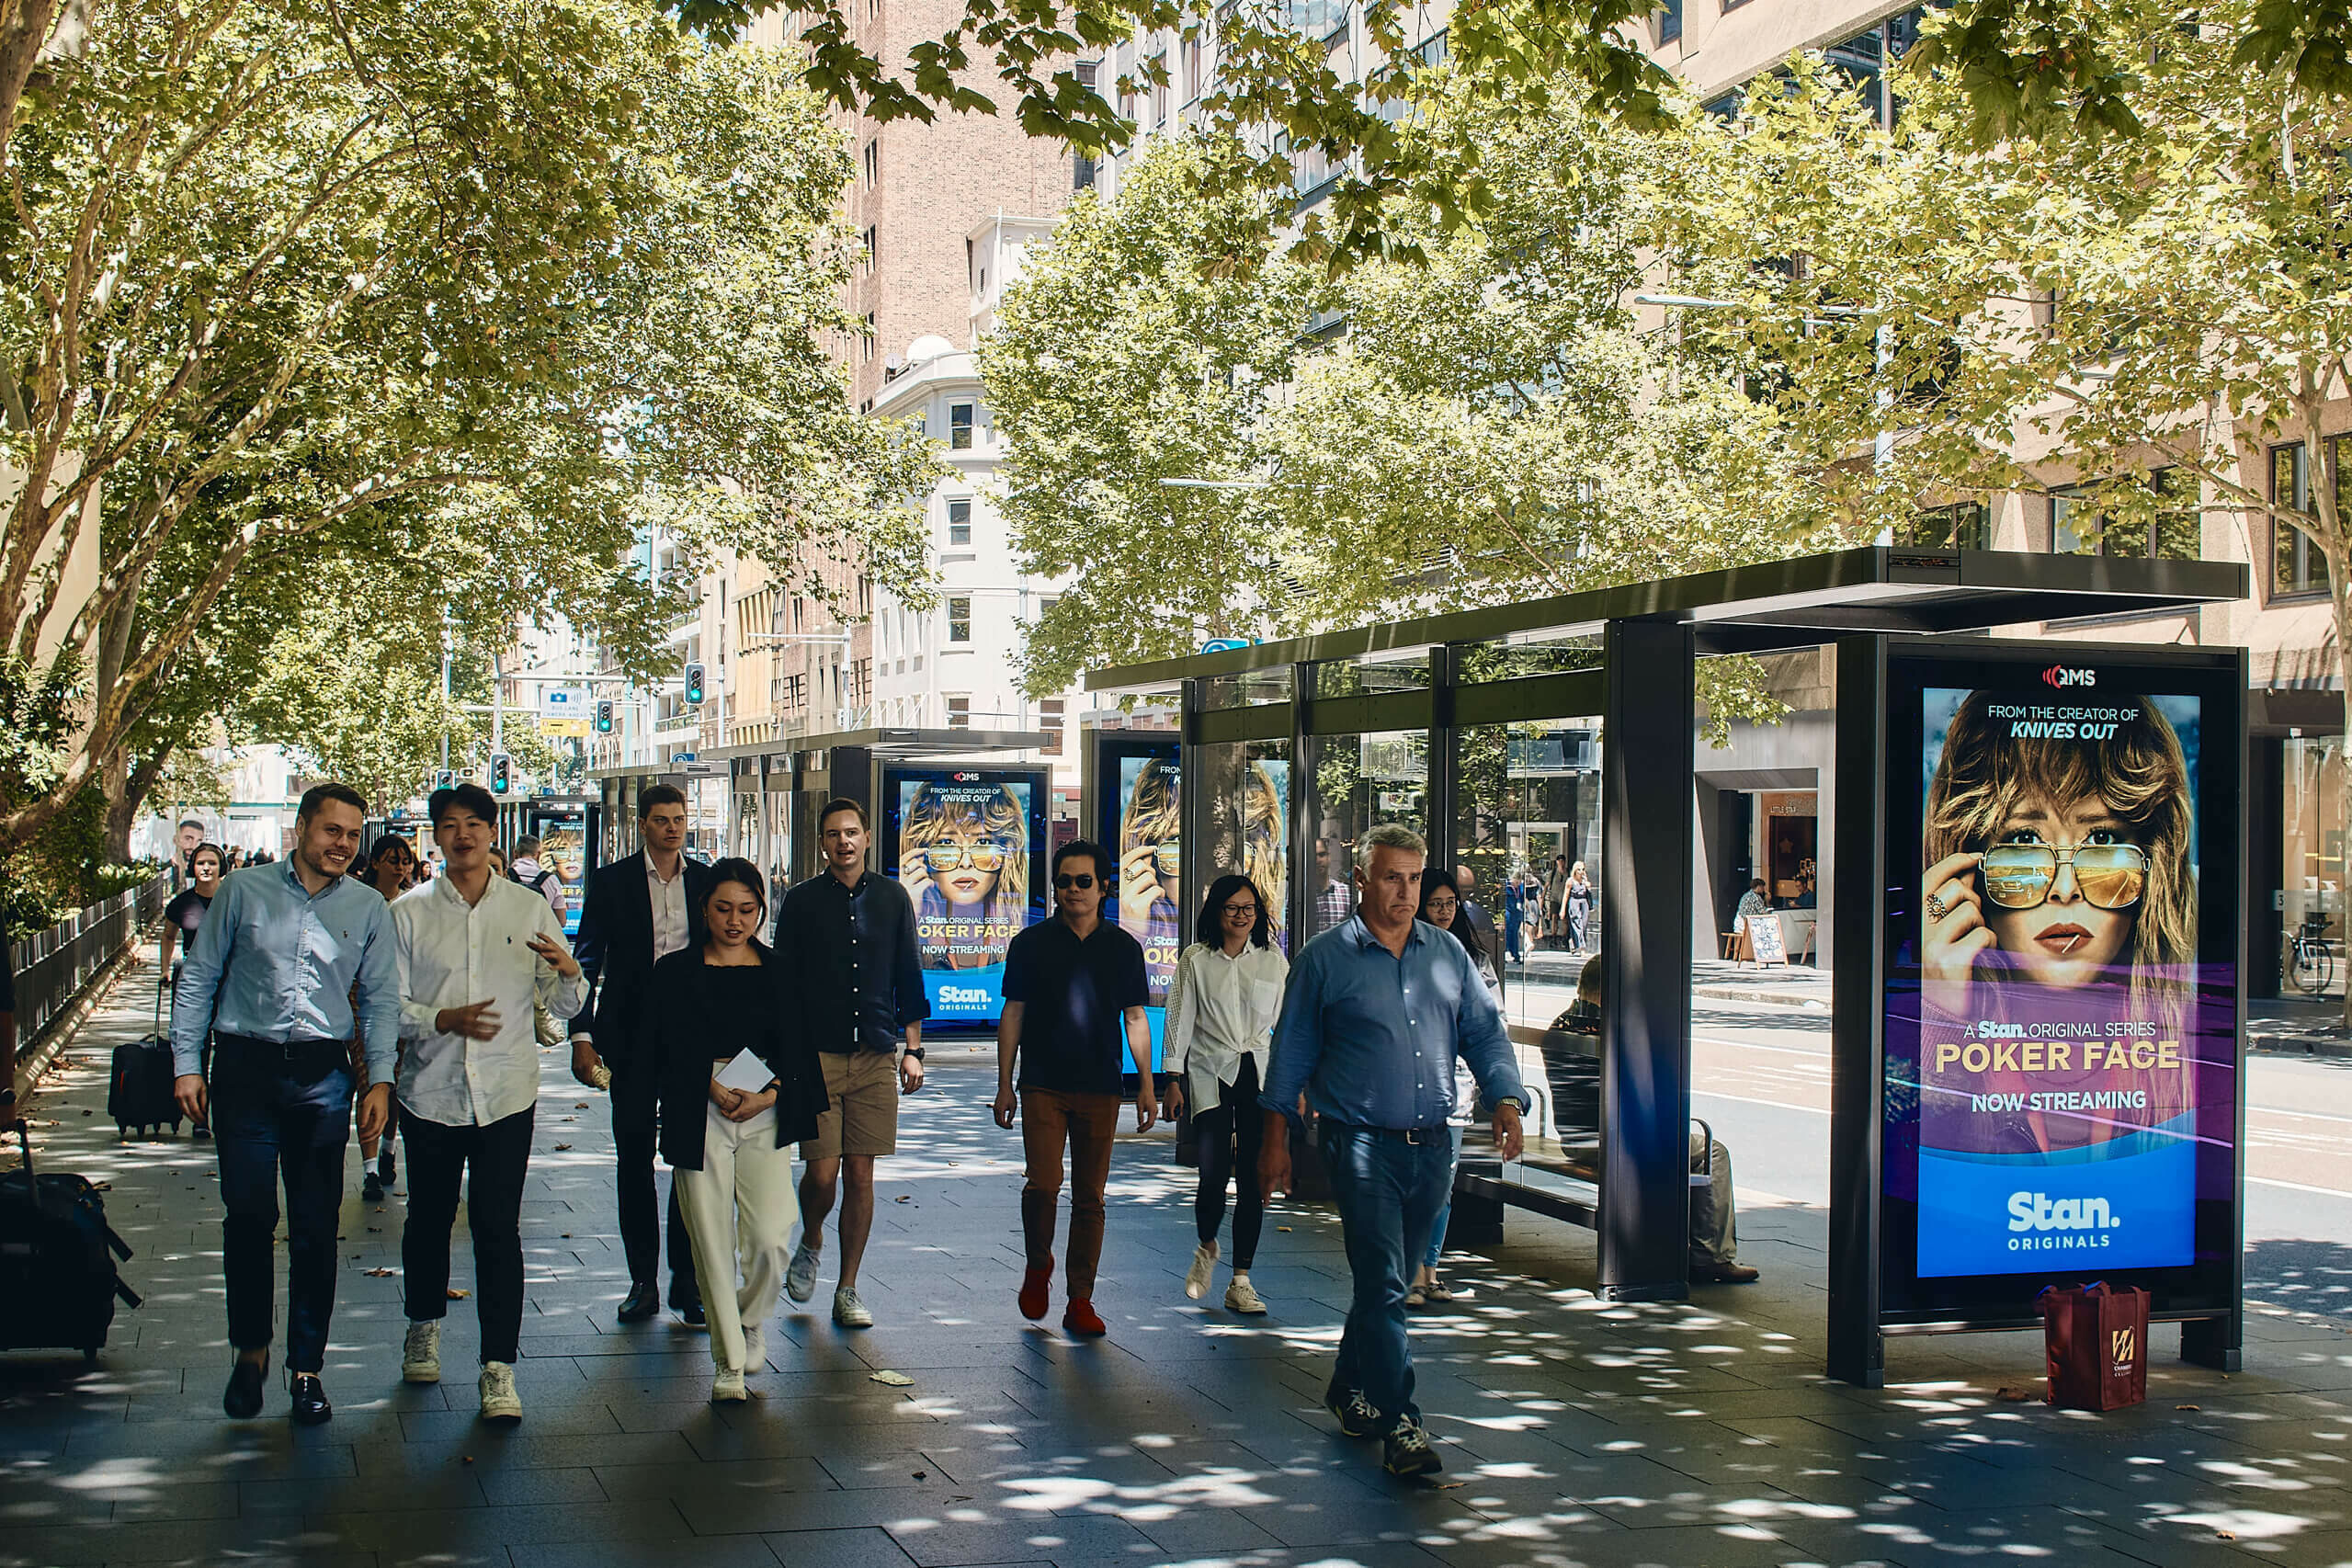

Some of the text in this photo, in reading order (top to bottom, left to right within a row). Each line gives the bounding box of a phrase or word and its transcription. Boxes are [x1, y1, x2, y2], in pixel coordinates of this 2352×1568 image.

[2051, 665, 2096, 688] QMS
[1988, 705, 2140, 722] FROM THE CREATOR OF
[2010, 722, 2119, 740] KNIVES OUT
[958, 772, 980, 782] QMS
[940, 794, 993, 802] KNIVES OUT
[918, 915, 1009, 925] A Stan. ORIGINAL SERIES
[917, 925, 1020, 937] OKER FACE
[922, 945, 1005, 954] NOW STREAMING
[1144, 937, 1153, 947] A
[938, 985, 993, 1003] Stan.
[1963, 1020, 2156, 1040] A Stan. ORIGINAL SERIES
[1936, 1040, 2180, 1074] POKER FACE
[1971, 1090, 2147, 1113] NOW STREAMING
[2007, 1191, 2121, 1232] Stan.
[2007, 1234, 2110, 1251] ORIGINALS
